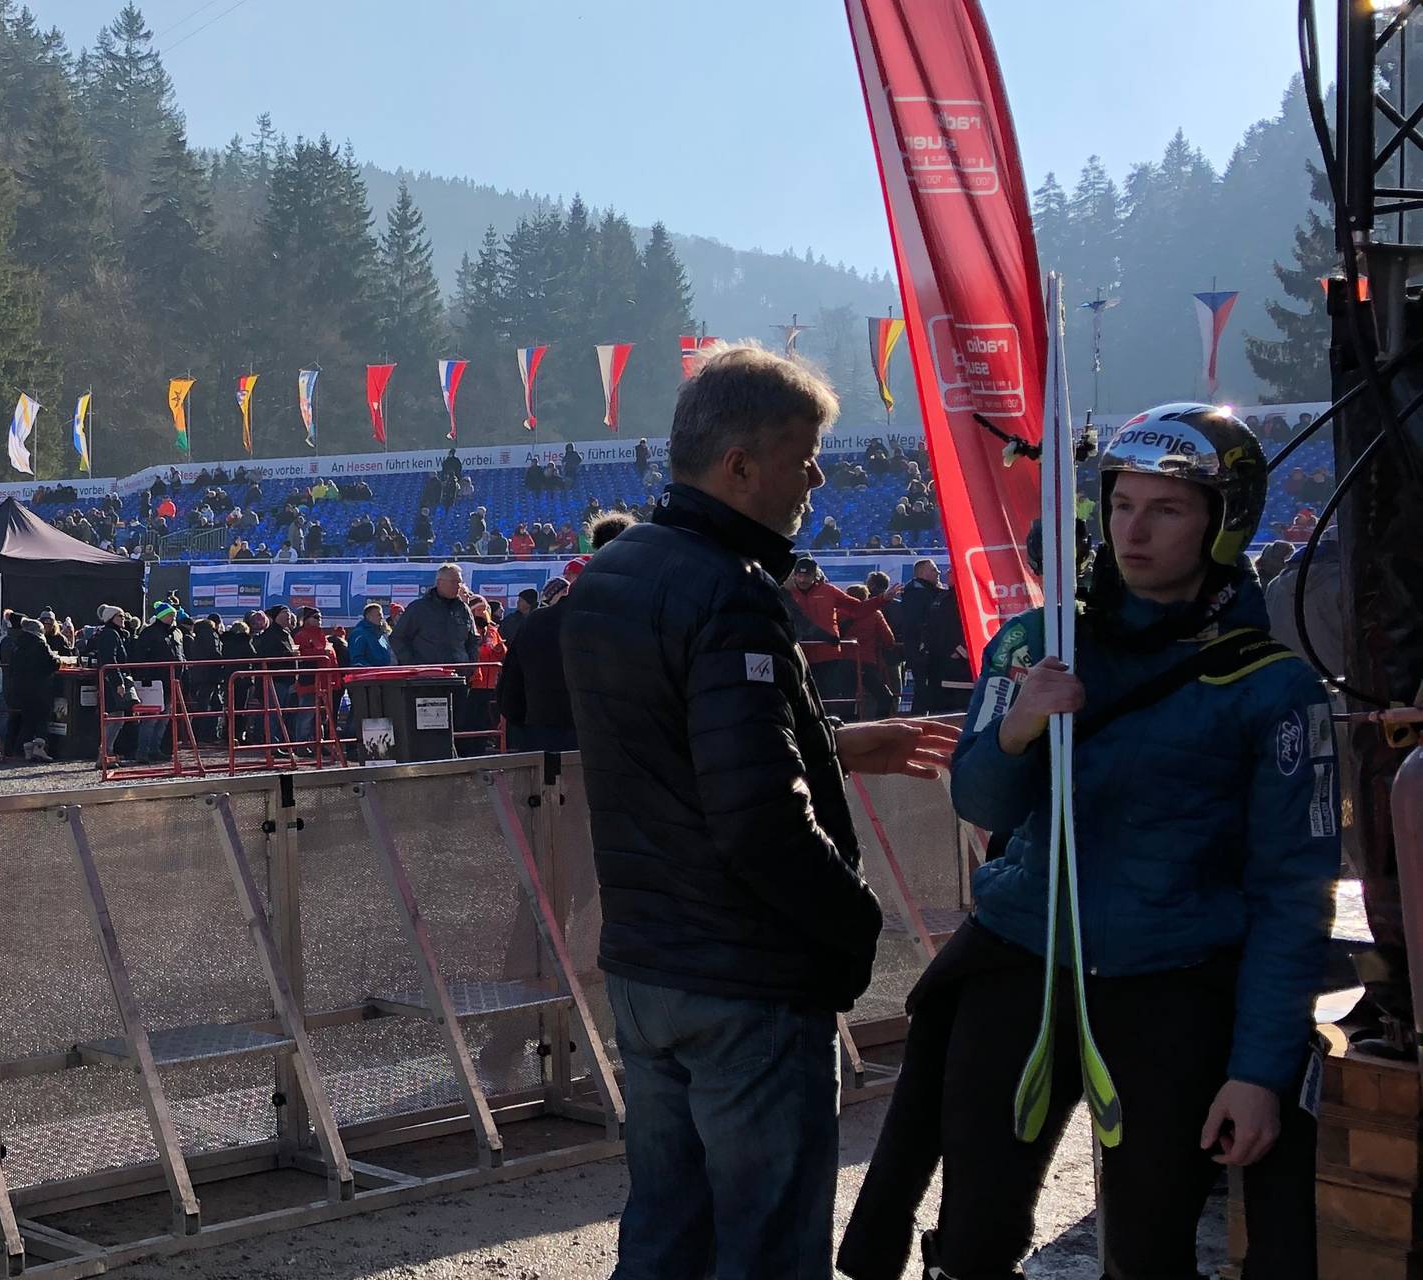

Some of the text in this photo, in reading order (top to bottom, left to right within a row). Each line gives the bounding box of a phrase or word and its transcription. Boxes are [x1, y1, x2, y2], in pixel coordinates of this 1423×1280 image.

[821, 436, 852, 449] führt
[1110, 429, 1197, 456] gorenje
[587, 448, 616, 460] führt
[618, 447, 637, 459] kei
[275, 464, 306, 476] vorbei.
[331, 462, 344, 473] An
[346, 461, 383, 472] Hessen
[385, 458, 409, 471] führt
[412, 457, 433, 469] kein
[1281, 720, 1300, 762] Ford
